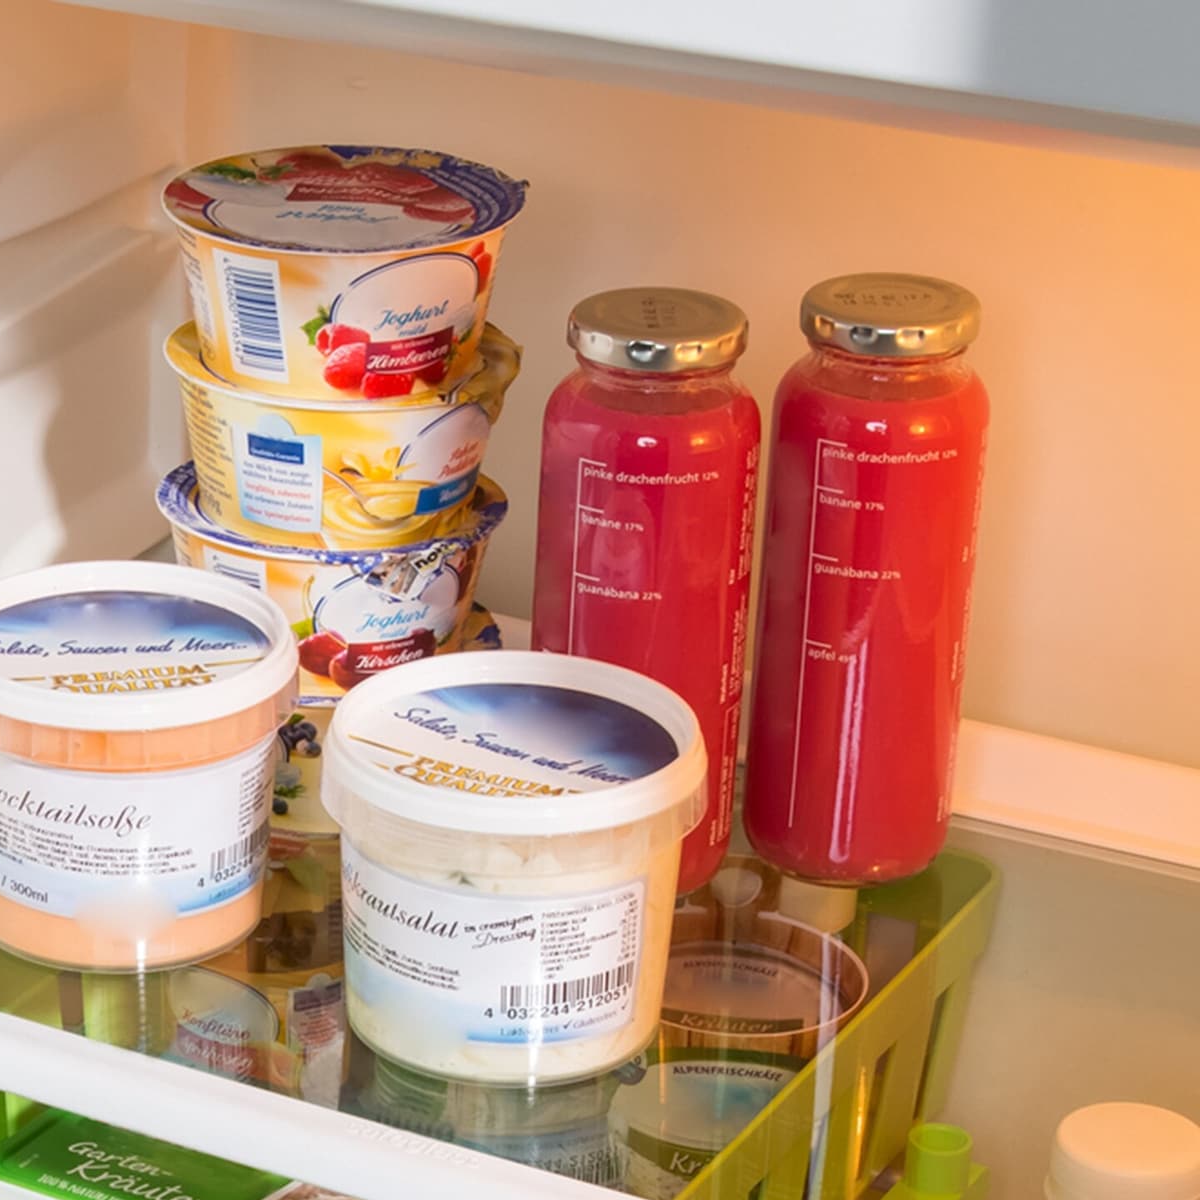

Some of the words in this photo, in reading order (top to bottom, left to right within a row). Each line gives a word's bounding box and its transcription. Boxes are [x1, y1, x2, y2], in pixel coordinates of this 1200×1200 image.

[374, 299, 449, 331] Joghurt
[366, 344, 450, 370] Himbeeren
[822, 447, 855, 461] pinke
[856, 451, 940, 464] drachenfrucht
[583, 466, 614, 480] pinke
[616, 472, 700, 485] drachenfrucht
[819, 493, 862, 510] banane
[865, 501, 885, 511] 17%
[581, 512, 622, 530] banane
[624, 522, 644, 532] 17%
[814, 562, 879, 580] guanábana
[881, 570, 901, 580] 22%
[577, 582, 640, 601] guanábana
[642, 591, 662, 601] 22%
[355, 604, 431, 633] Joghurt
[56, 639, 128, 656] Saucen
[134, 638, 174, 655] und
[355, 648, 424, 669] Kirschen
[807, 647, 836, 665] apfel
[52, 663, 208, 686] PREMIUM
[461, 731, 532, 761] Saucen
[531, 759, 584, 772] und
[412, 755, 565, 797] PREMIUM
[10, 880, 49, 904] 300ml
[471, 927, 537, 950] Dressing
[483, 1007, 494, 1019] 4
[576, 984, 629, 1013] 212051
[67, 1141, 175, 1177] Garten-
